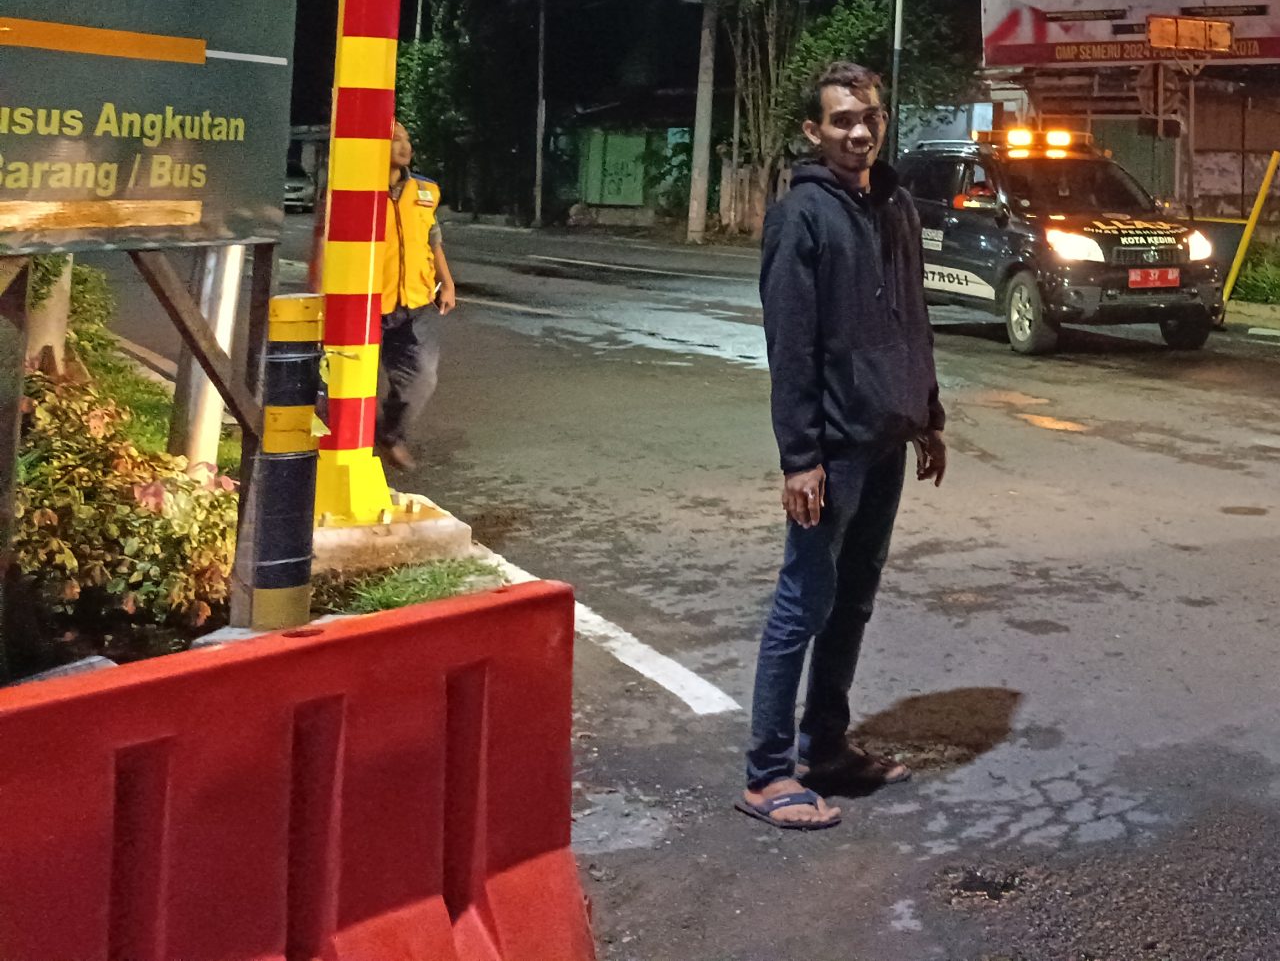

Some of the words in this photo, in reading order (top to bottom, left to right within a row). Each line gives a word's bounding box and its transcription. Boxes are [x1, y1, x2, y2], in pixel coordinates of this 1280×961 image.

[1055, 44, 1077, 60] OMP
[1080, 43, 1121, 59] SEMERU
[1123, 42, 1150, 58] 2024
[94, 102, 246, 147] Angkutan
[0, 152, 118, 197] arang
[127, 153, 141, 189] /
[150, 154, 207, 189] Bus
[1120, 236, 1147, 245] KOTA
[1147, 236, 1177, 246] KEDIRI
